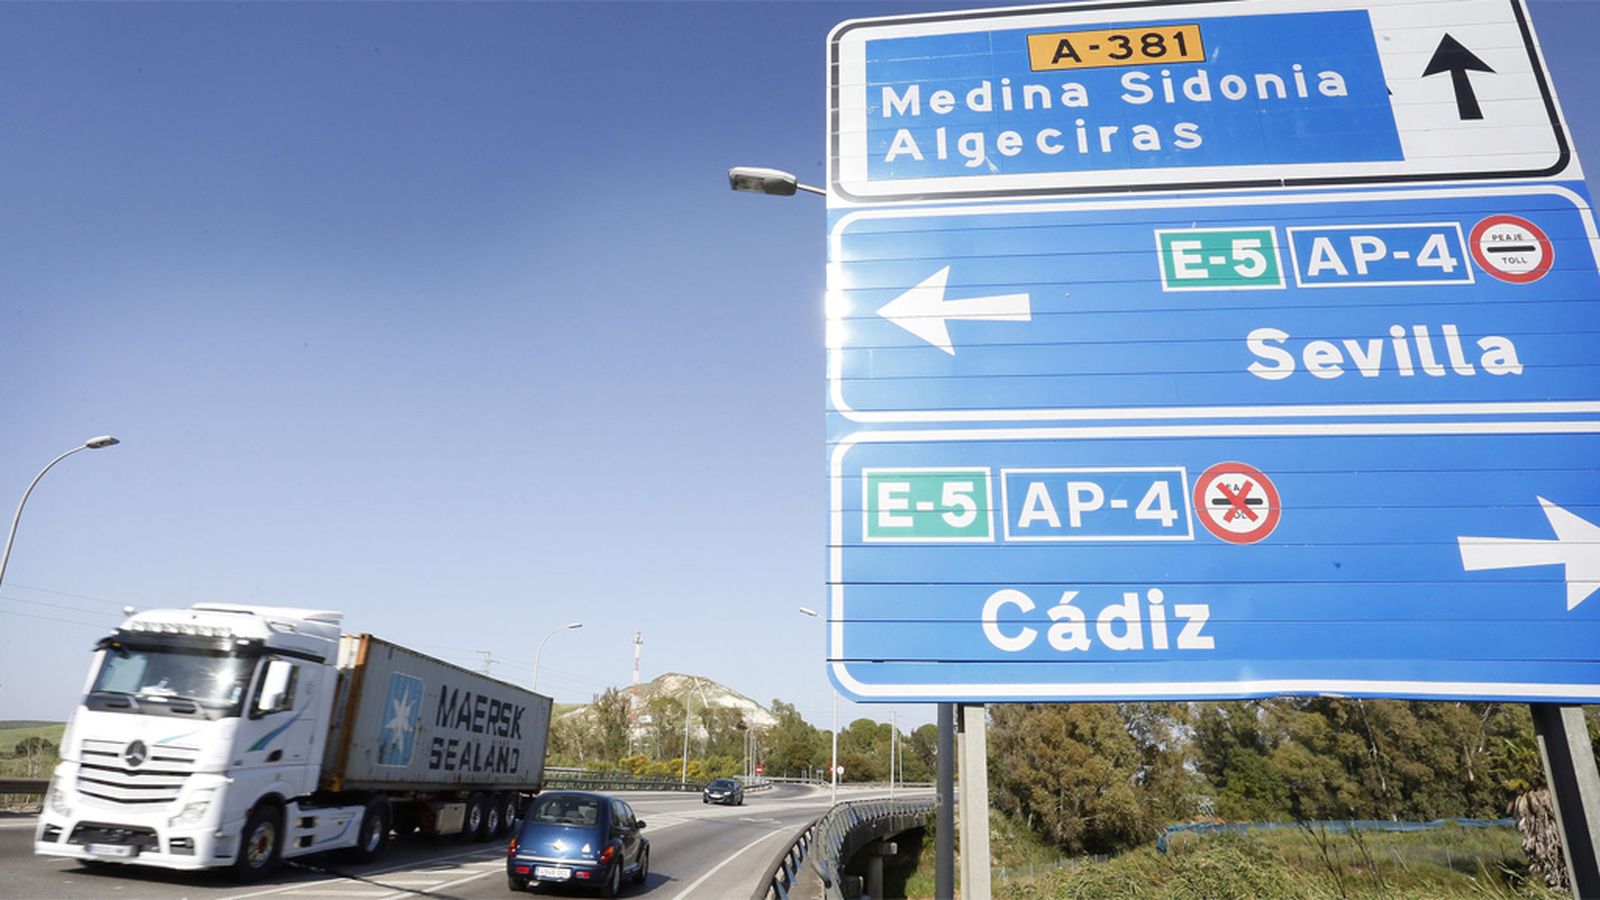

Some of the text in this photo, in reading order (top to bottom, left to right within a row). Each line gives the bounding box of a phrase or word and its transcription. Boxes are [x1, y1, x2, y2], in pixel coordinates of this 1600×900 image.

[1051, 32, 1190, 65] A-381
[882, 63, 1348, 118] Medina Sidonia
[884, 120, 1204, 171] Algeciras
[1170, 239, 1267, 280] E-5
[1307, 233, 1458, 277] AP-4
[1491, 233, 1525, 242] PEAJE
[1501, 256, 1528, 265] TOLL
[1246, 324, 1524, 380] Sevilla
[877, 481, 978, 528] E-5
[1017, 480, 1179, 528] AP-4
[981, 588, 1216, 652] Cádiz
[435, 685, 526, 741] MAERSK
[429, 737, 520, 774] SEALAND
